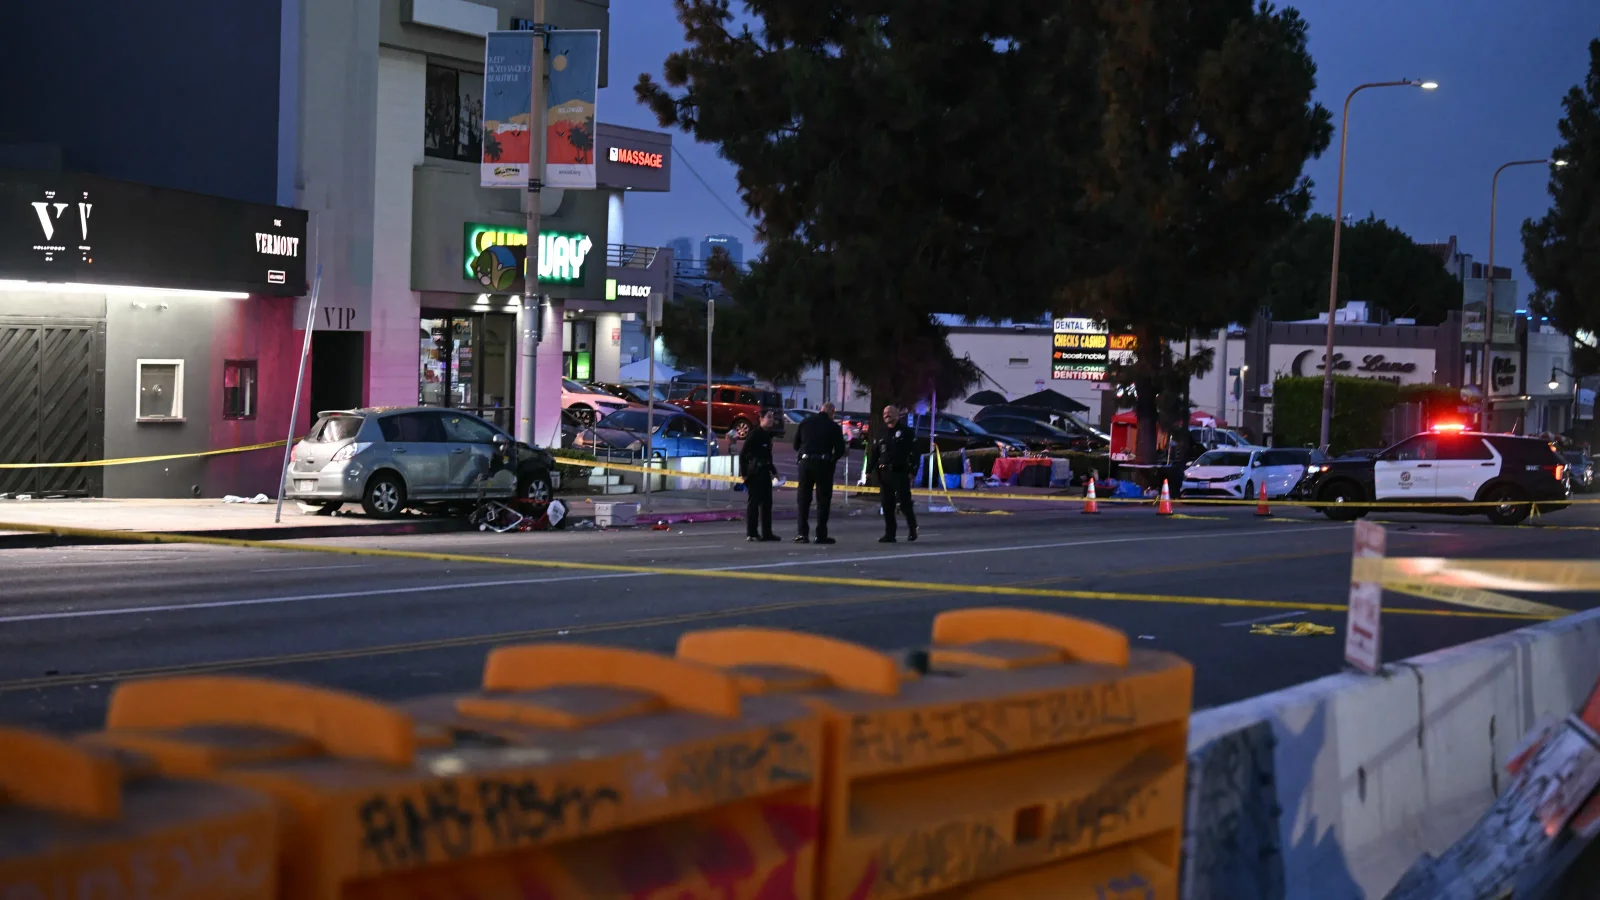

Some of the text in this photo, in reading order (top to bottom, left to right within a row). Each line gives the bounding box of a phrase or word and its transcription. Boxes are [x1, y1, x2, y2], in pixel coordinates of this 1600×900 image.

[487, 64, 531, 73] HOLLYWOOD
[488, 55, 506, 64] KEEP
[487, 73, 519, 82] BEAUTIFUL
[618, 148, 663, 169] MASSAGE
[31, 201, 69, 241] V
[255, 232, 299, 258] VERMONT
[470, 230, 593, 279] SWAY
[323, 306, 356, 330] VIP
[1055, 321, 1083, 330] DENTAL
[1054, 333, 1107, 348] CHECKS CASHED
[1316, 352, 1416, 373] La Luna
[1054, 372, 1105, 380] DENTISTRY
